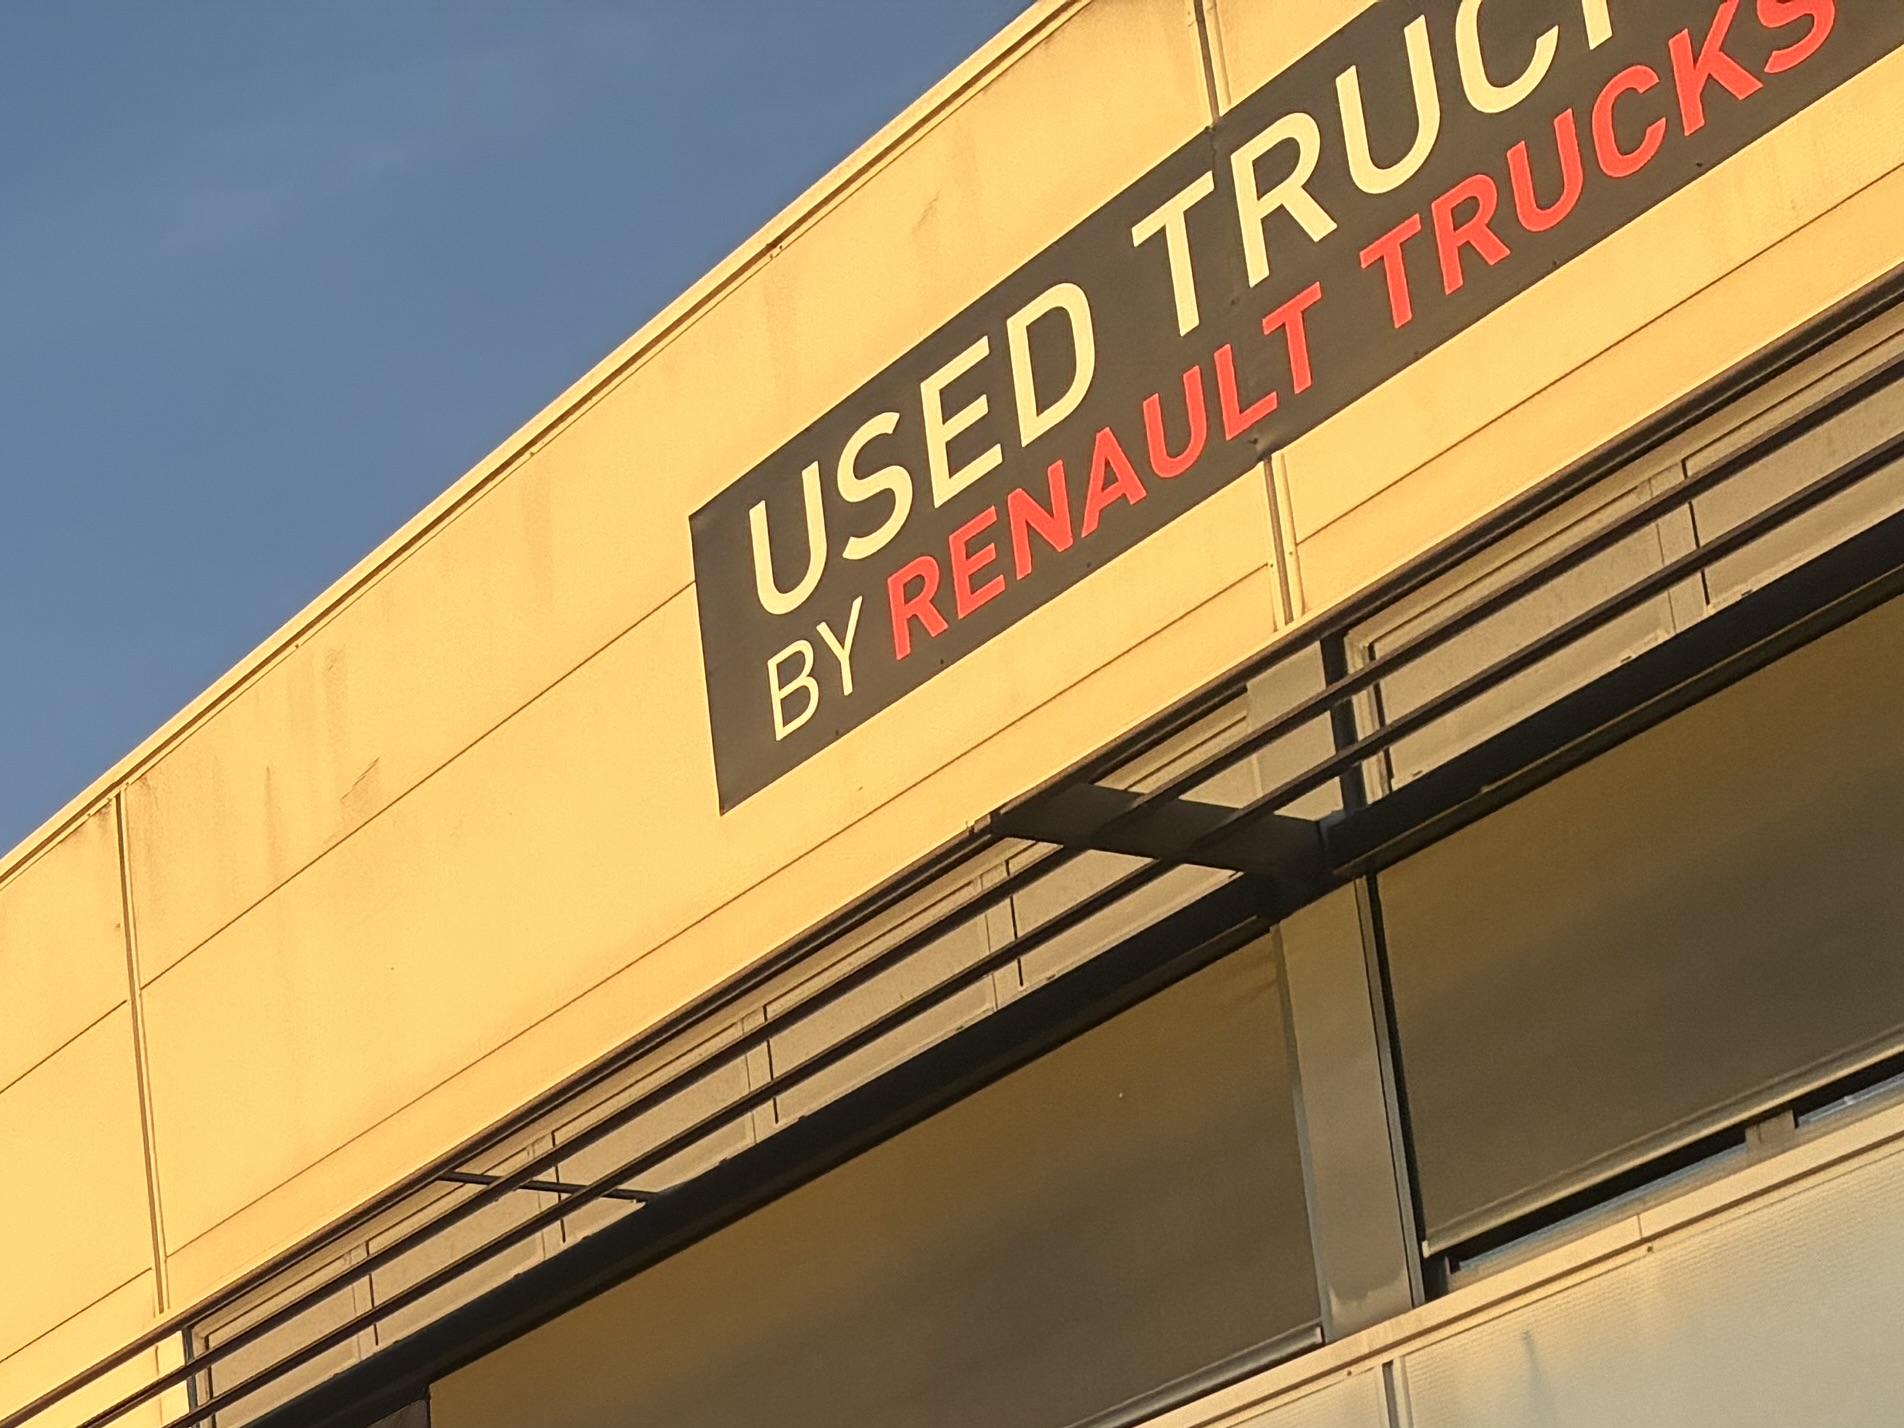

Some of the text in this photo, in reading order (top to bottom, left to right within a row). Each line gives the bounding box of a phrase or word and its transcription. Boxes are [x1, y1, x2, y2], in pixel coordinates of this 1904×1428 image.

[748, 282, 1096, 616] USED
[766, 0, 1836, 742] BY RENAULT TRUCKS
